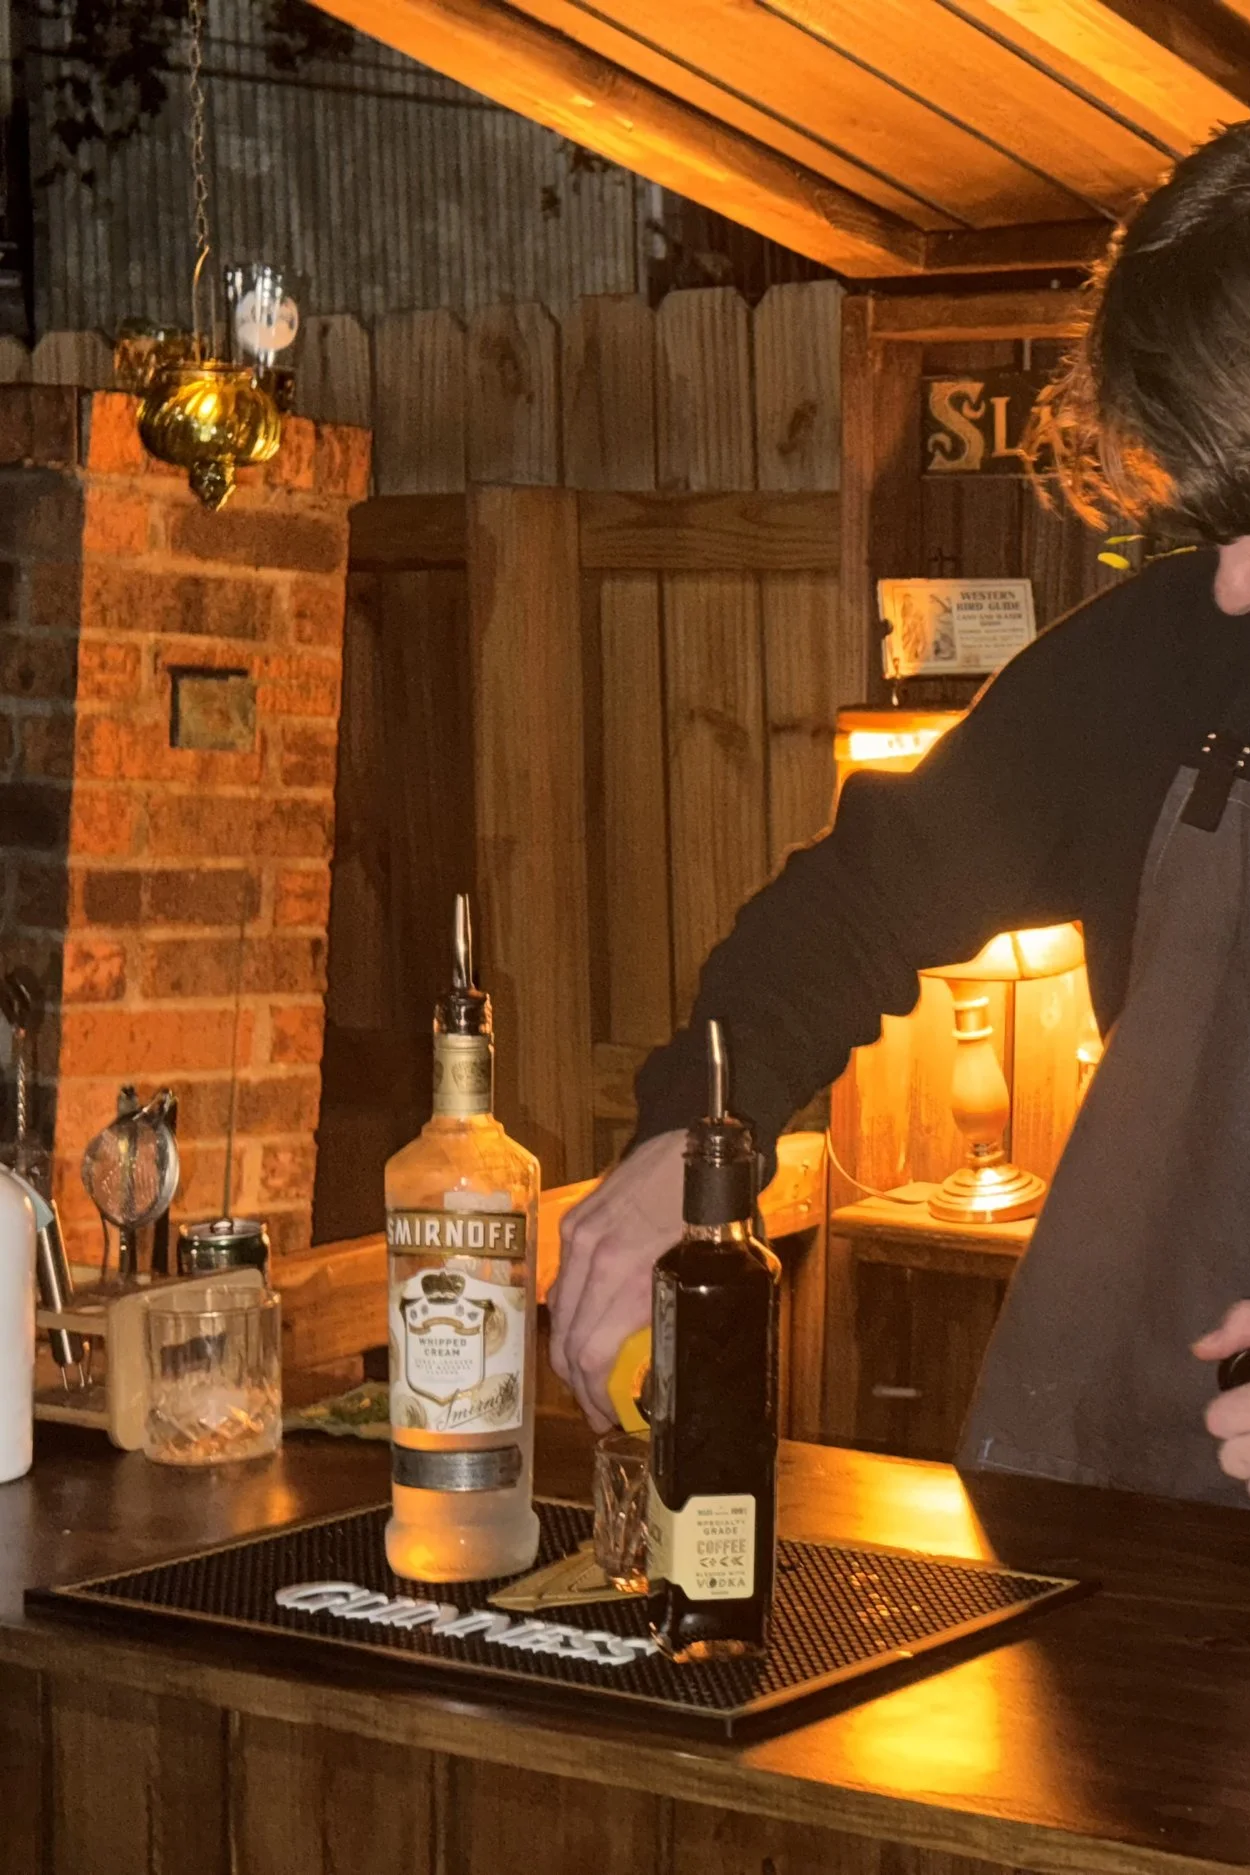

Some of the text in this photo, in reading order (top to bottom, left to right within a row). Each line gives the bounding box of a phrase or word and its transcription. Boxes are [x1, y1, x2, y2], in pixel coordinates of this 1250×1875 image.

[387, 1217, 517, 1249] SMIRNOFF
[419, 1337, 467, 1347] WHIPPED
[424, 1348, 461, 1357] CREAM
[703, 1527, 738, 1536] GRADE
[696, 1538, 747, 1555] COFFEE
[696, 1577, 746, 1589] VODKA
